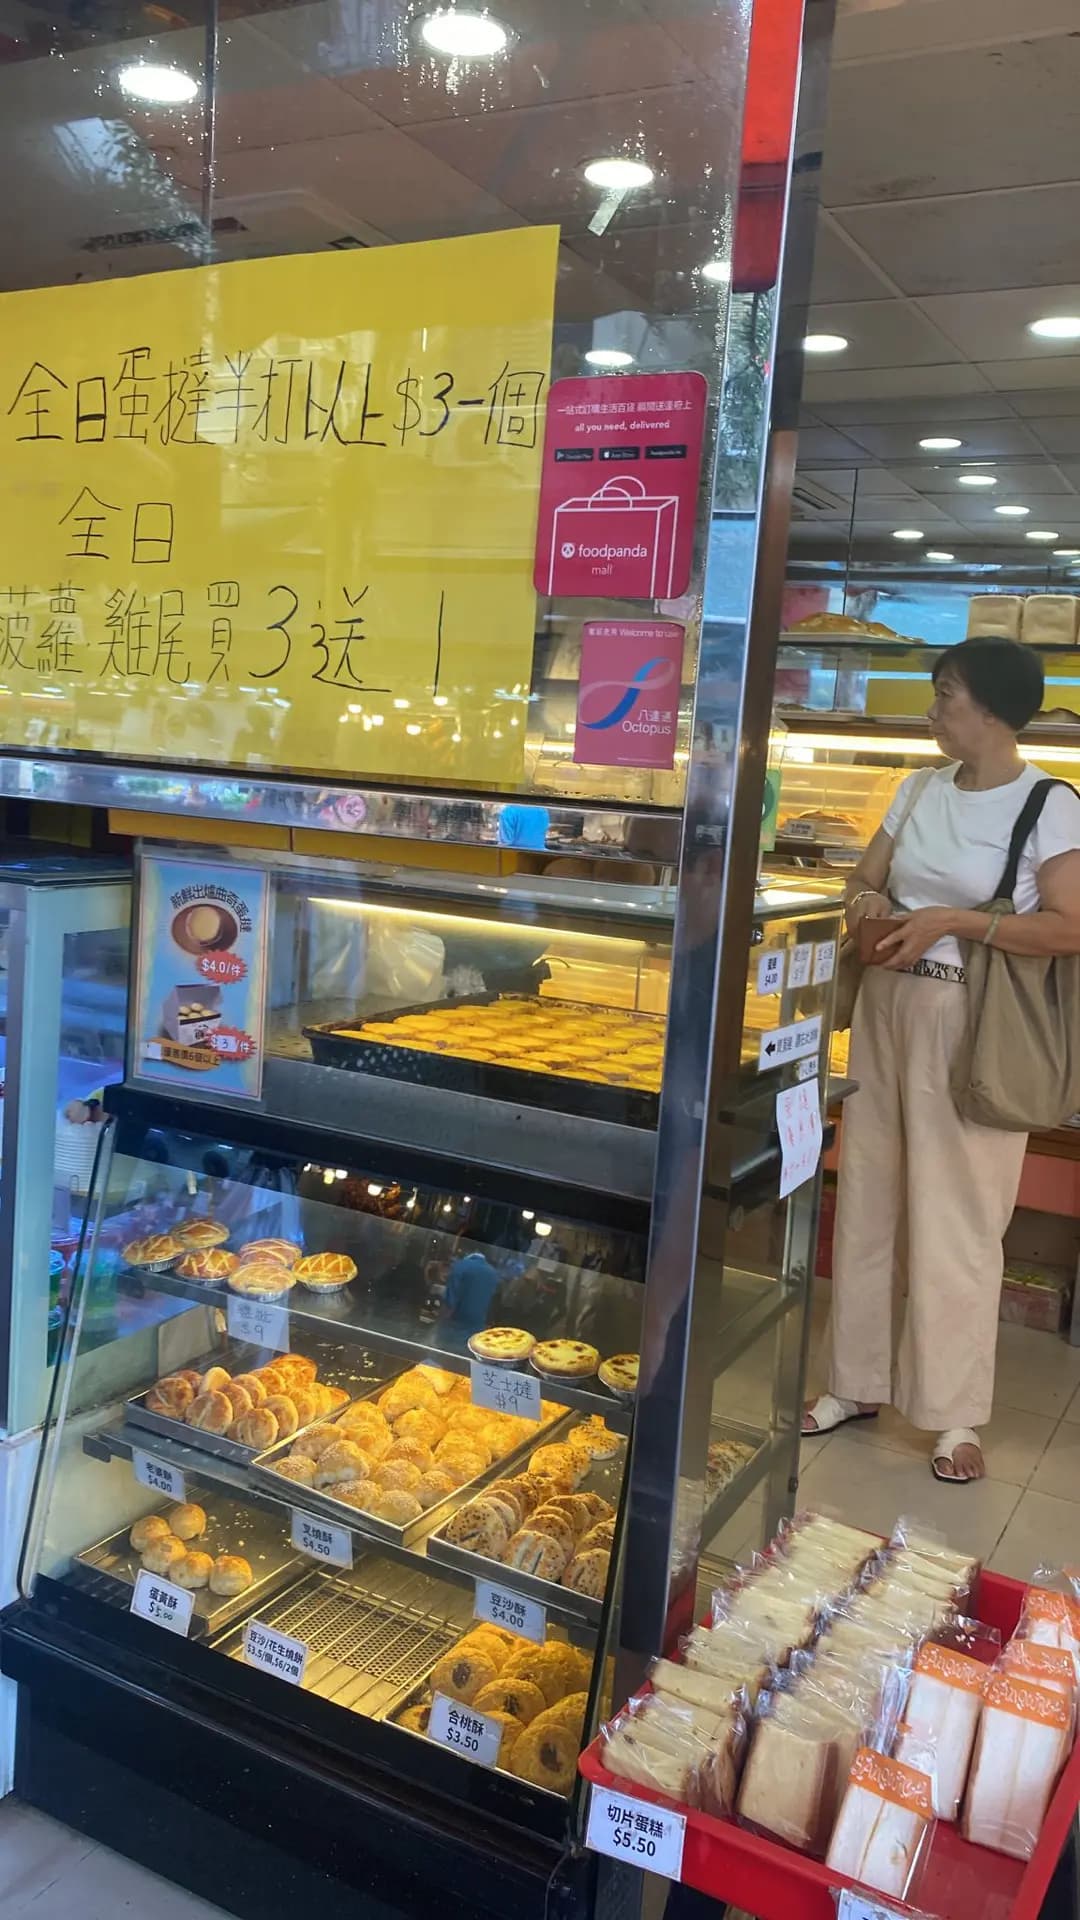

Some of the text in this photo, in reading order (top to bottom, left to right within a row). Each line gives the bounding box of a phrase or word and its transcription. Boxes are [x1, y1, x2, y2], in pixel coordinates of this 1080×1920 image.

[575, 423, 585, 432] all
[586, 424, 602, 434] you
[630, 420, 670, 430] delivered
[59, 486, 173, 563] 全日
[579, 543, 648, 560] foodpanda
[592, 563, 613, 575] mall
[619, 628, 654, 638] Welcome
[655, 629, 664, 638] to
[622, 720, 672, 736] Octopus
[201, 959, 241, 977] $4.0/件
[148, 1474, 172, 1492] $4.00
[303, 1523, 332, 1544] 叉燒酥
[303, 1537, 330, 1556] $4.50
[149, 1586, 178, 1610] 蛋黃酥
[490, 1592, 527, 1617] 豆沙酥
[491, 1606, 524, 1628] $4.00
[448, 1710, 485, 1737] 合桃酥
[446, 1727, 479, 1752] $3.50
[606, 1804, 665, 1839] 切片蛋糕
[611, 1828, 656, 1857] $5.50
